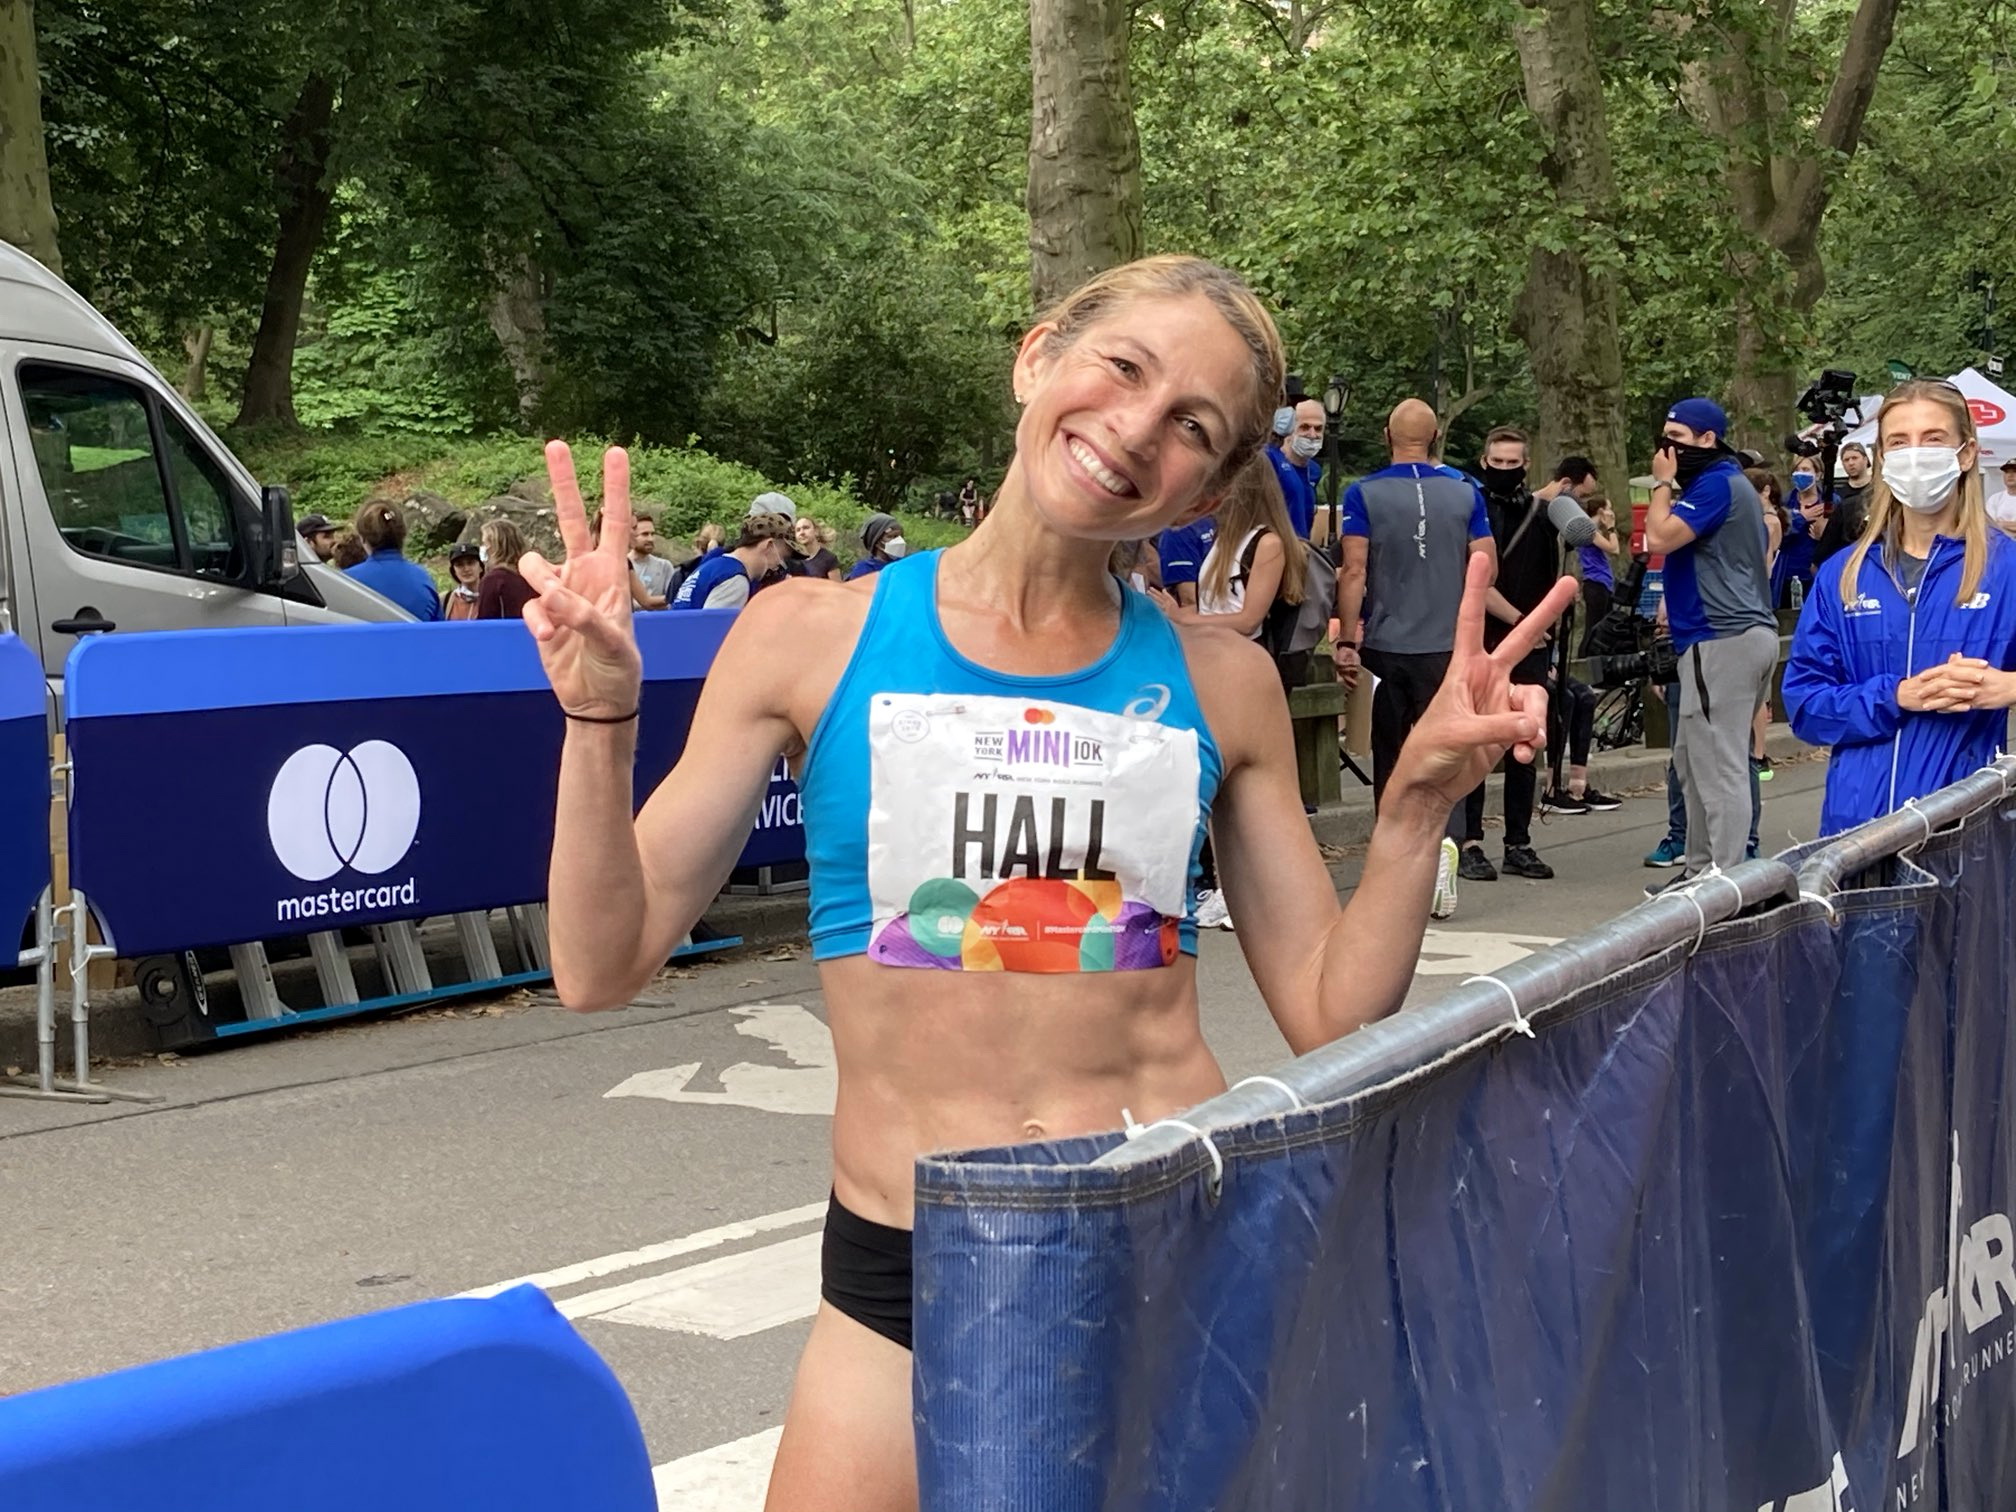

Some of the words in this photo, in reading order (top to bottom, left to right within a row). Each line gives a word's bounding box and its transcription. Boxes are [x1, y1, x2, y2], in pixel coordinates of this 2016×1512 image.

[974, 736, 1004, 746] NEW
[1007, 729, 1070, 768] MINI
[1074, 740, 1103, 761] 10K
[974, 747, 1003, 756] YORK
[952, 791, 1116, 881] HALL
[277, 876, 415, 921] mastercard
